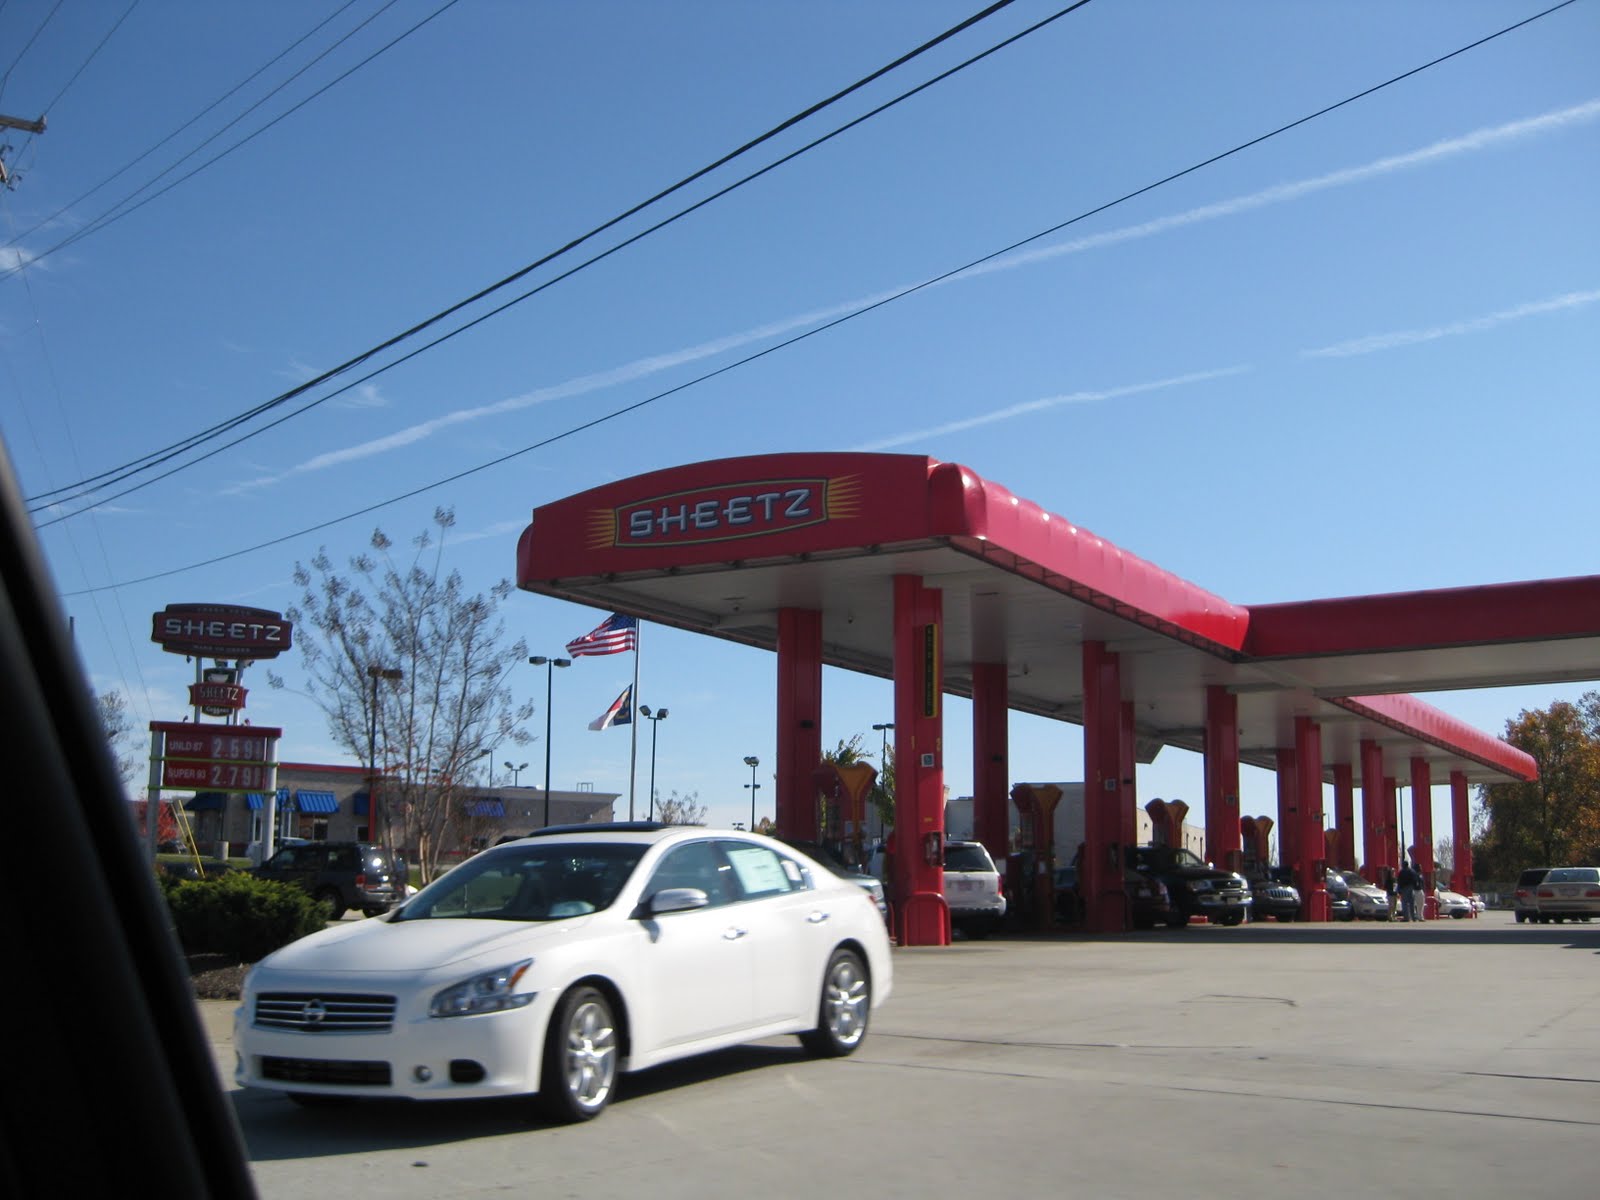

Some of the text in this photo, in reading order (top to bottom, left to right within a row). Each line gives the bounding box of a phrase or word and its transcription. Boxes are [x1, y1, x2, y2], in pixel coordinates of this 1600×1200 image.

[630, 488, 811, 537] SHEETZ
[165, 618, 281, 641] SHEETZ
[169, 740, 192, 751] UNLD
[193, 742, 203, 752] 87
[168, 767, 195, 778] SUPER
